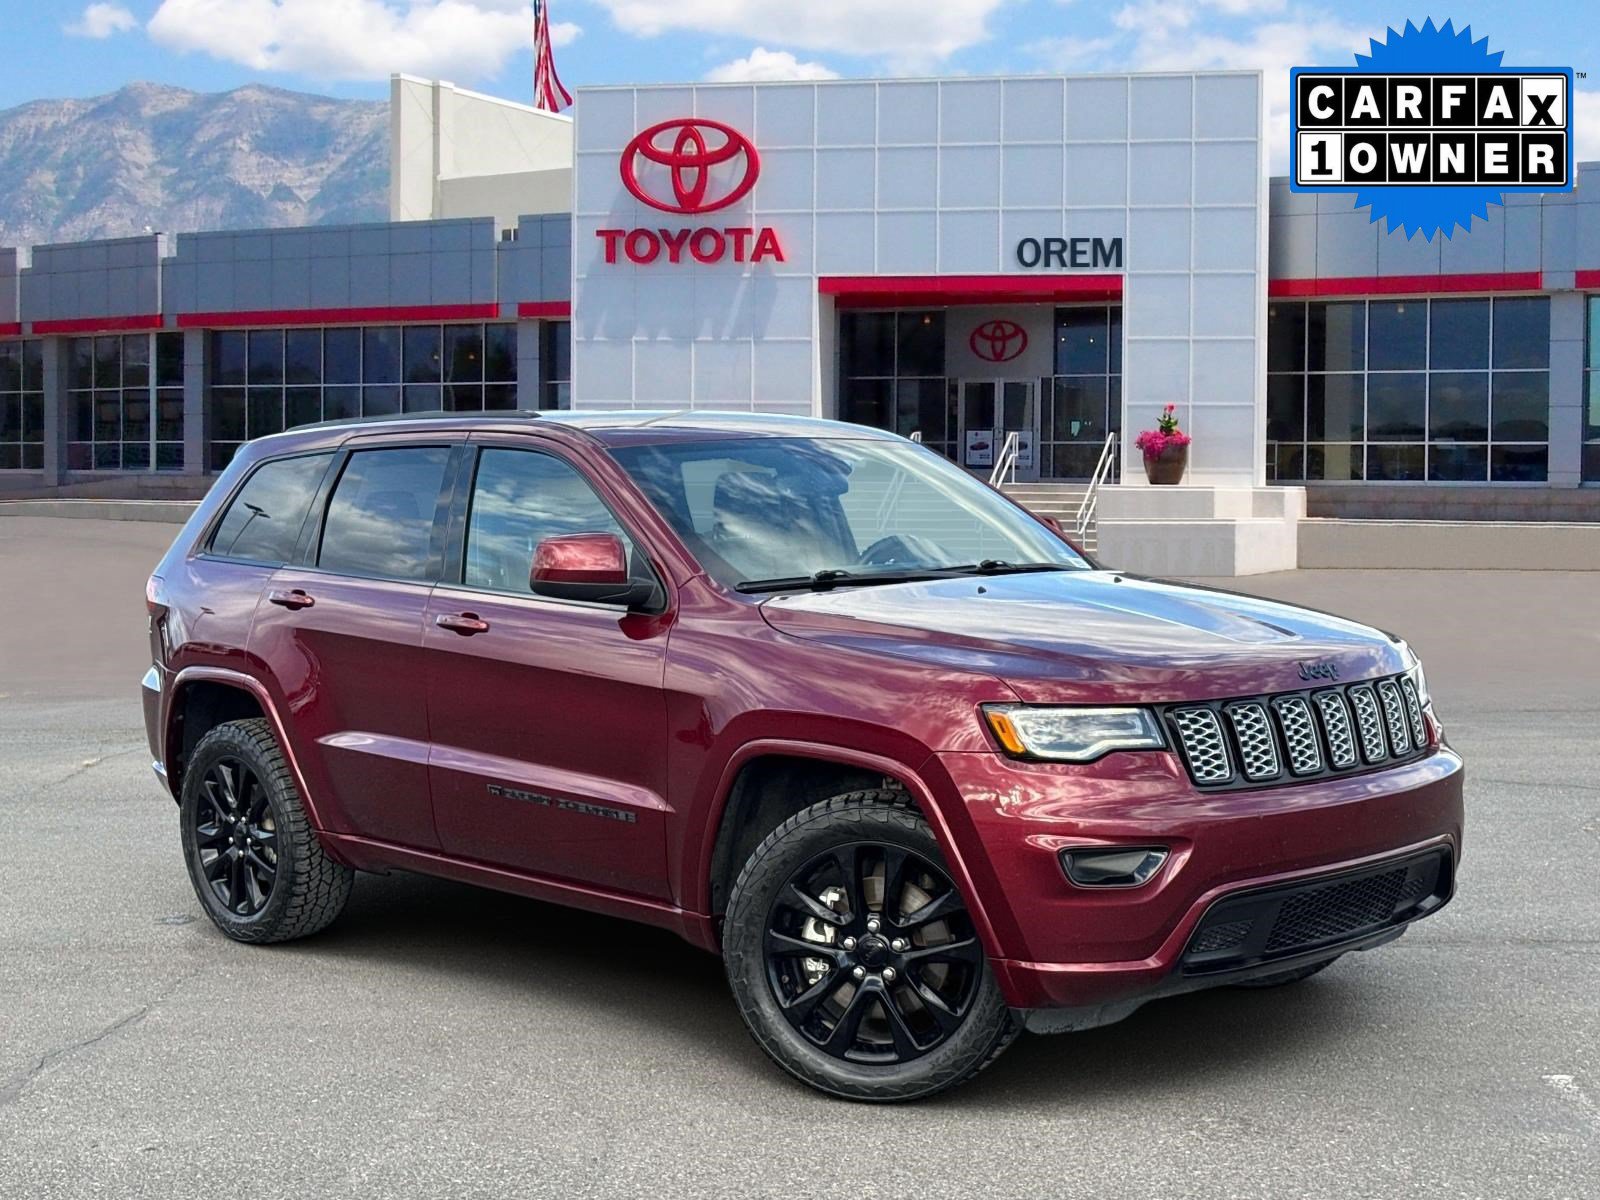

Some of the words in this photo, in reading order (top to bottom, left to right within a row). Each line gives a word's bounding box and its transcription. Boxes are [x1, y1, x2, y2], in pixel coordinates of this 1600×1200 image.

[596, 227, 785, 265] TOYOTA
[1017, 237, 1123, 268] OREM
[1297, 661, 1340, 682] Jeep
